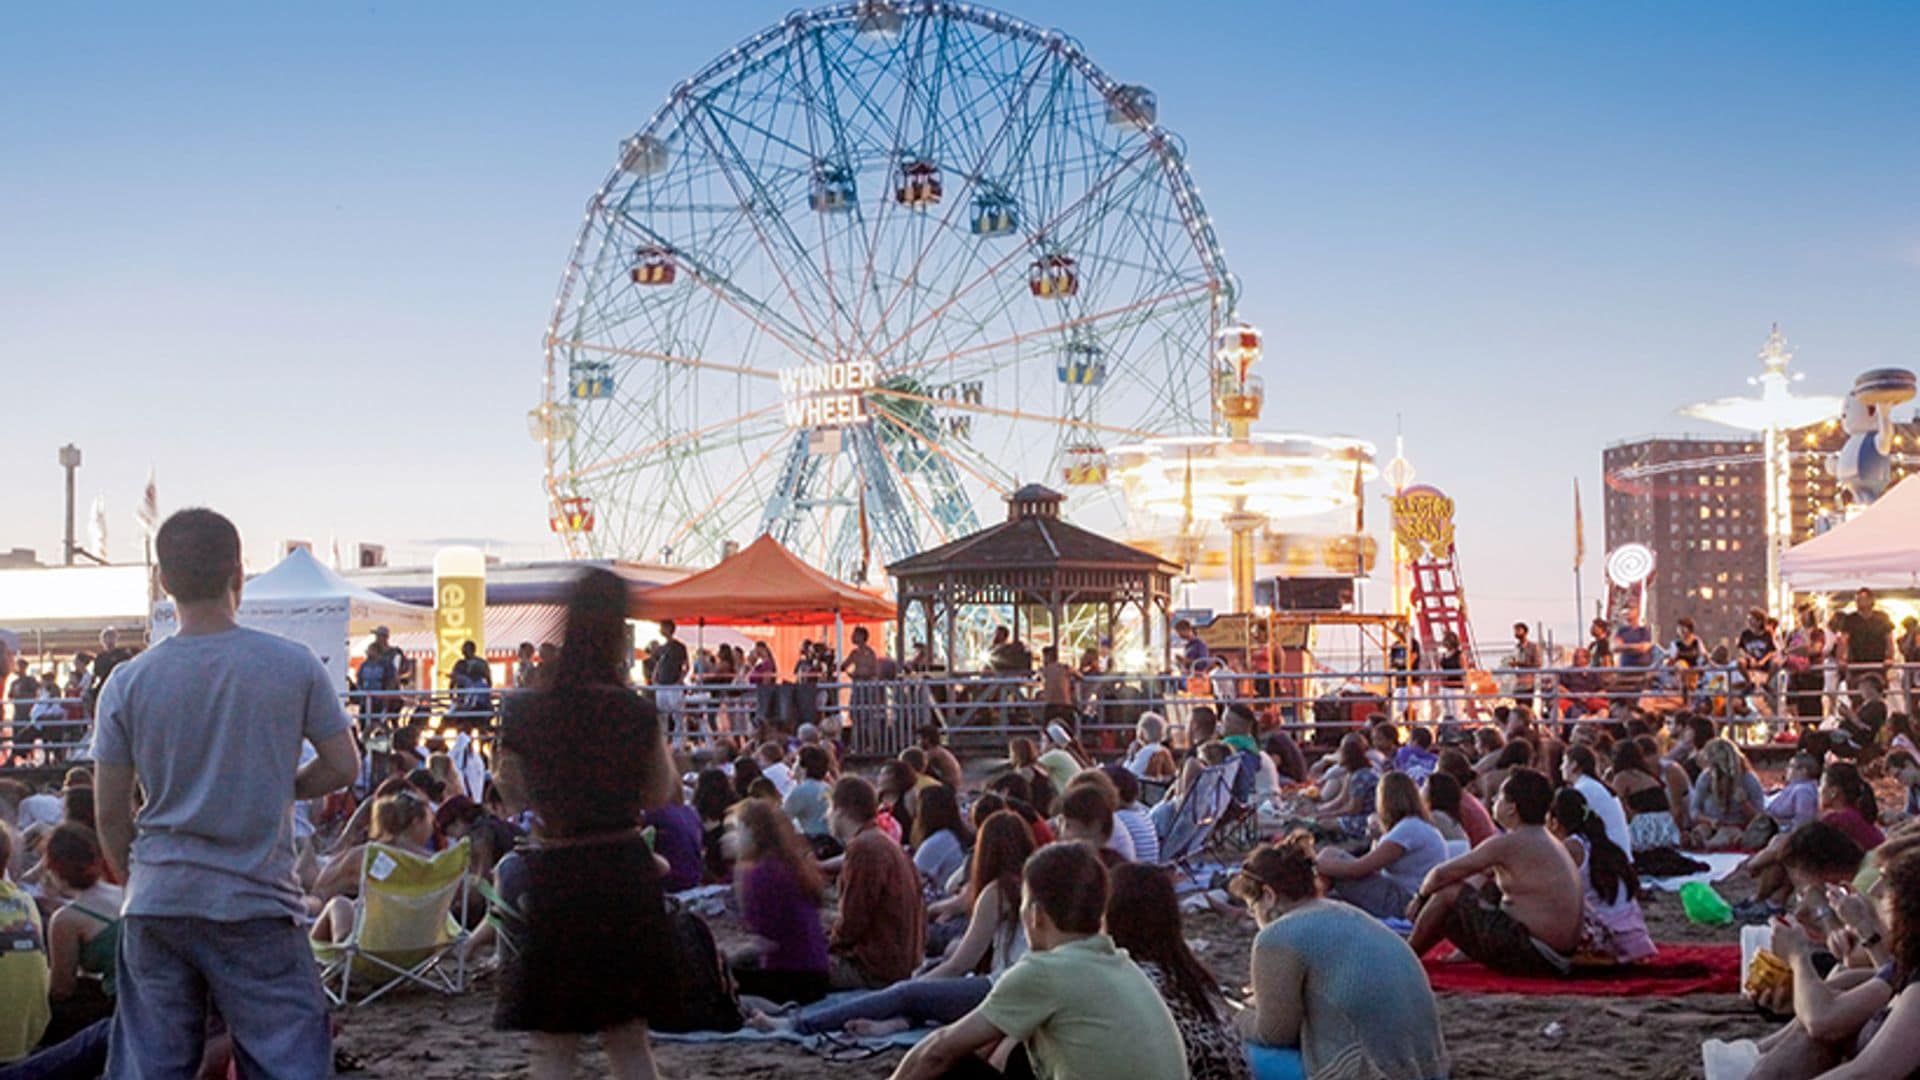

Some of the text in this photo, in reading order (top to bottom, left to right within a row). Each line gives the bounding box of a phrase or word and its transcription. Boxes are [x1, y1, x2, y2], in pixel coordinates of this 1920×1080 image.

[779, 361, 875, 394] WONDER
[784, 395, 869, 427] WHEEL
[440, 583, 472, 660] epix
